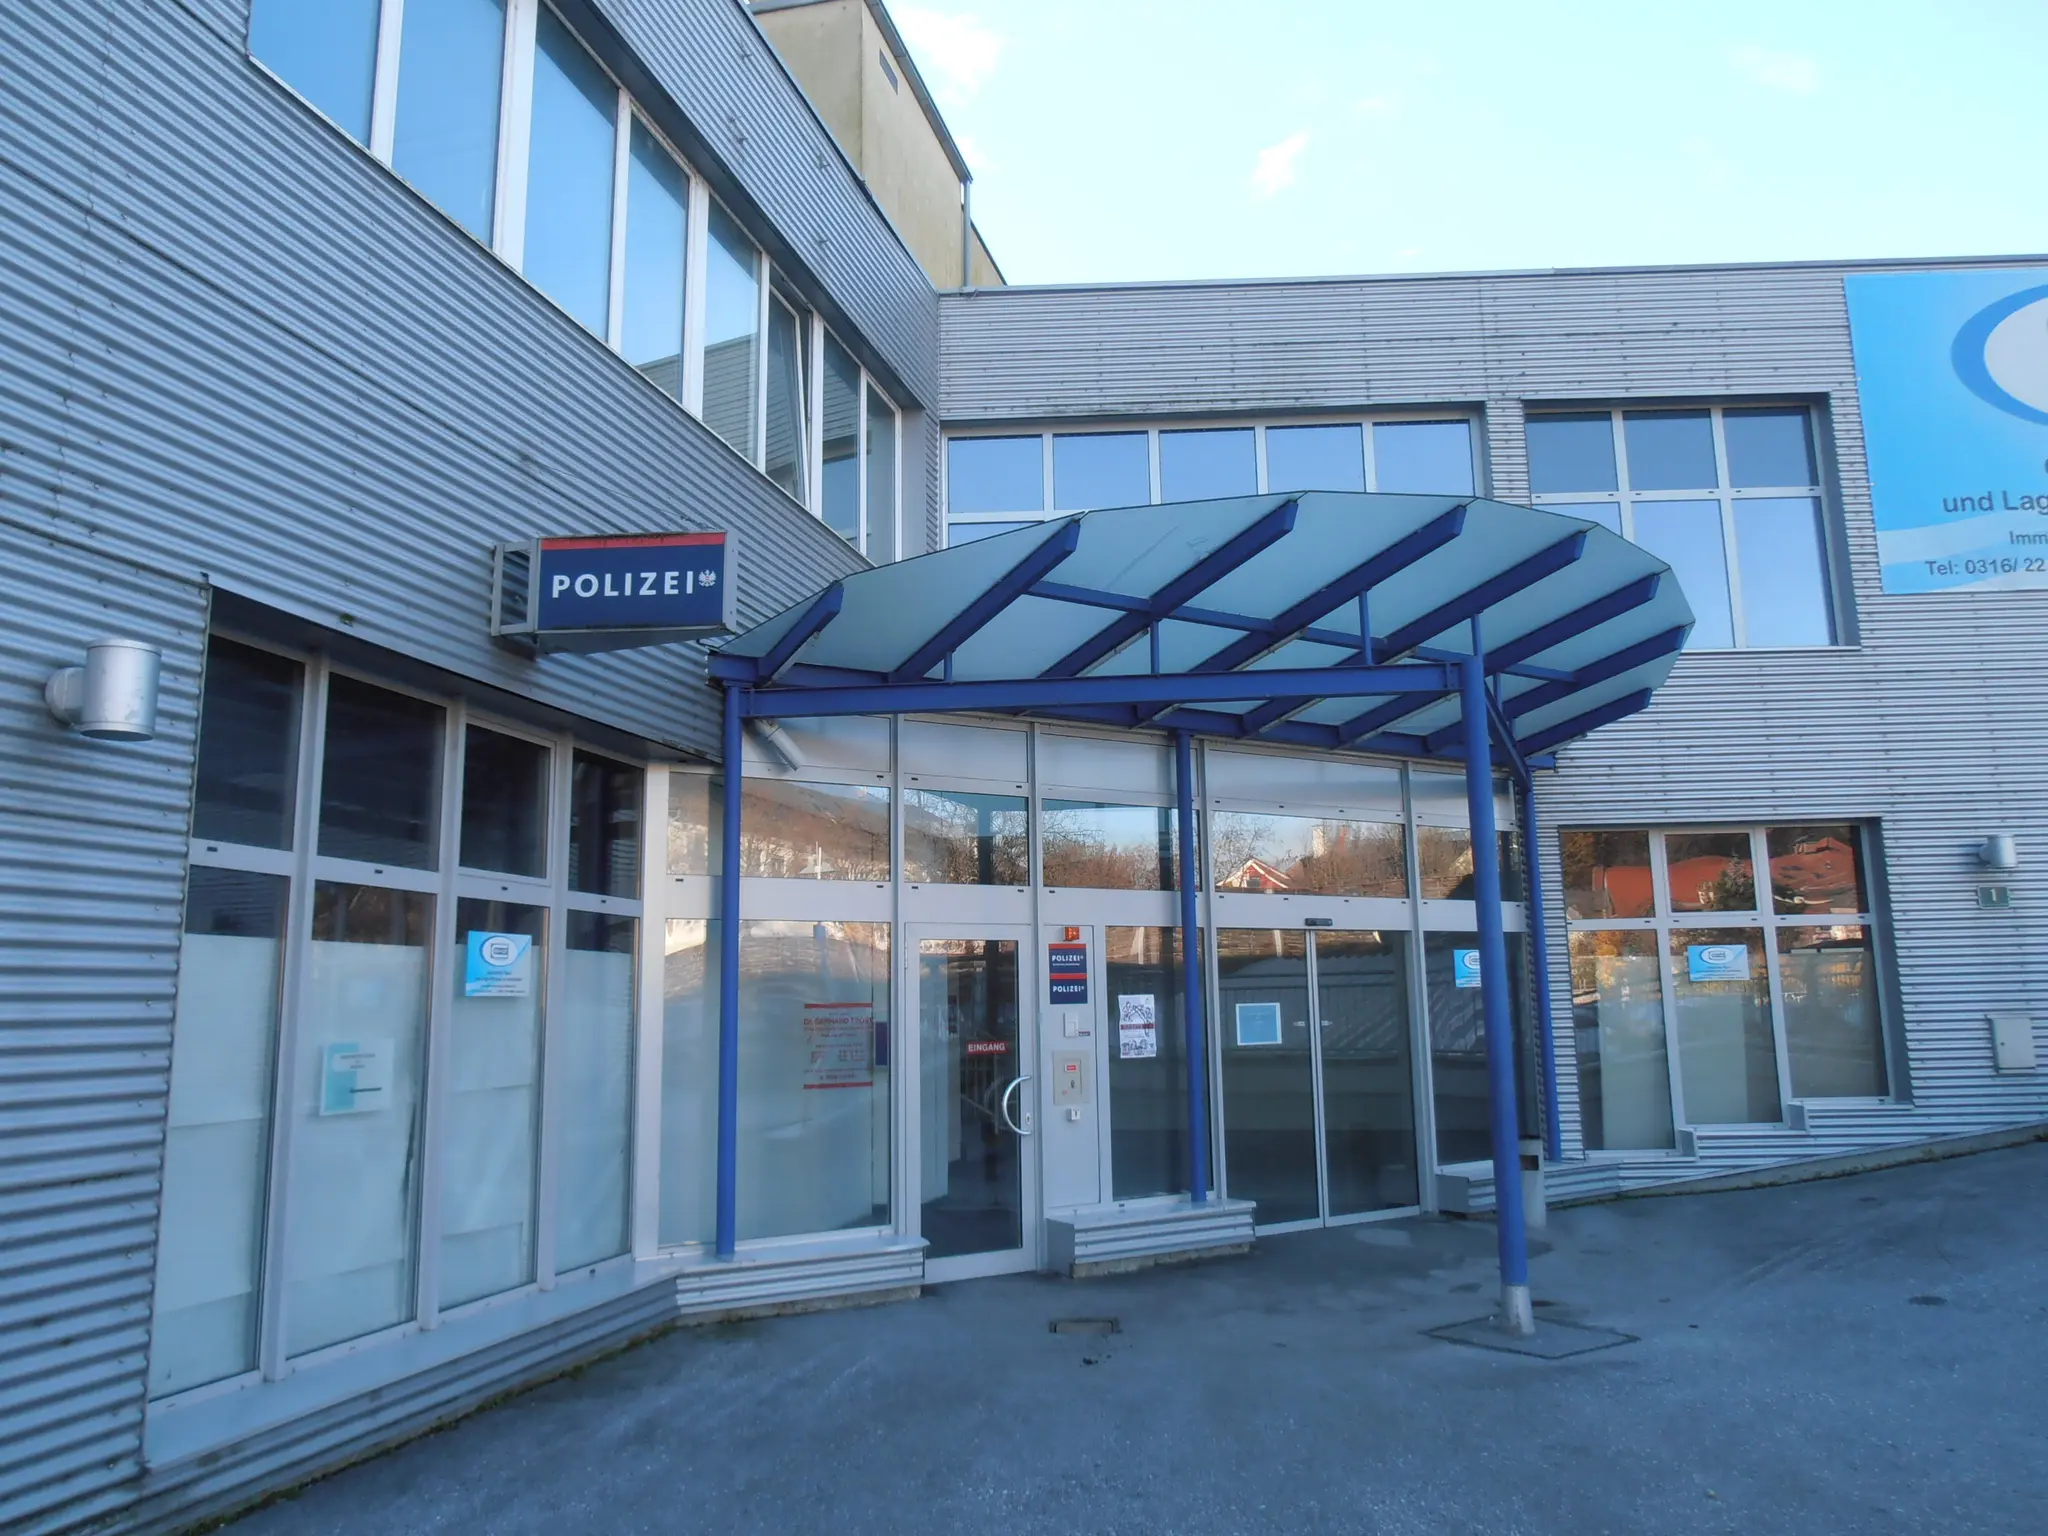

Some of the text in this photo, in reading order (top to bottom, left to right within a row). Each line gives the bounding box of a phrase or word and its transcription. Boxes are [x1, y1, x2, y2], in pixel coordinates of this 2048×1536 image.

[1942, 489, 2048, 516] und Lag
[1925, 557, 2046, 576] Tel: 0316/ 22
[552, 571, 694, 598] POLIZEI
[1989, 888, 1997, 902] 1
[1051, 954, 1081, 962] POLIZEI
[1052, 985, 1081, 993] POLIZEI
[967, 1042, 1006, 1052] EINGANG
